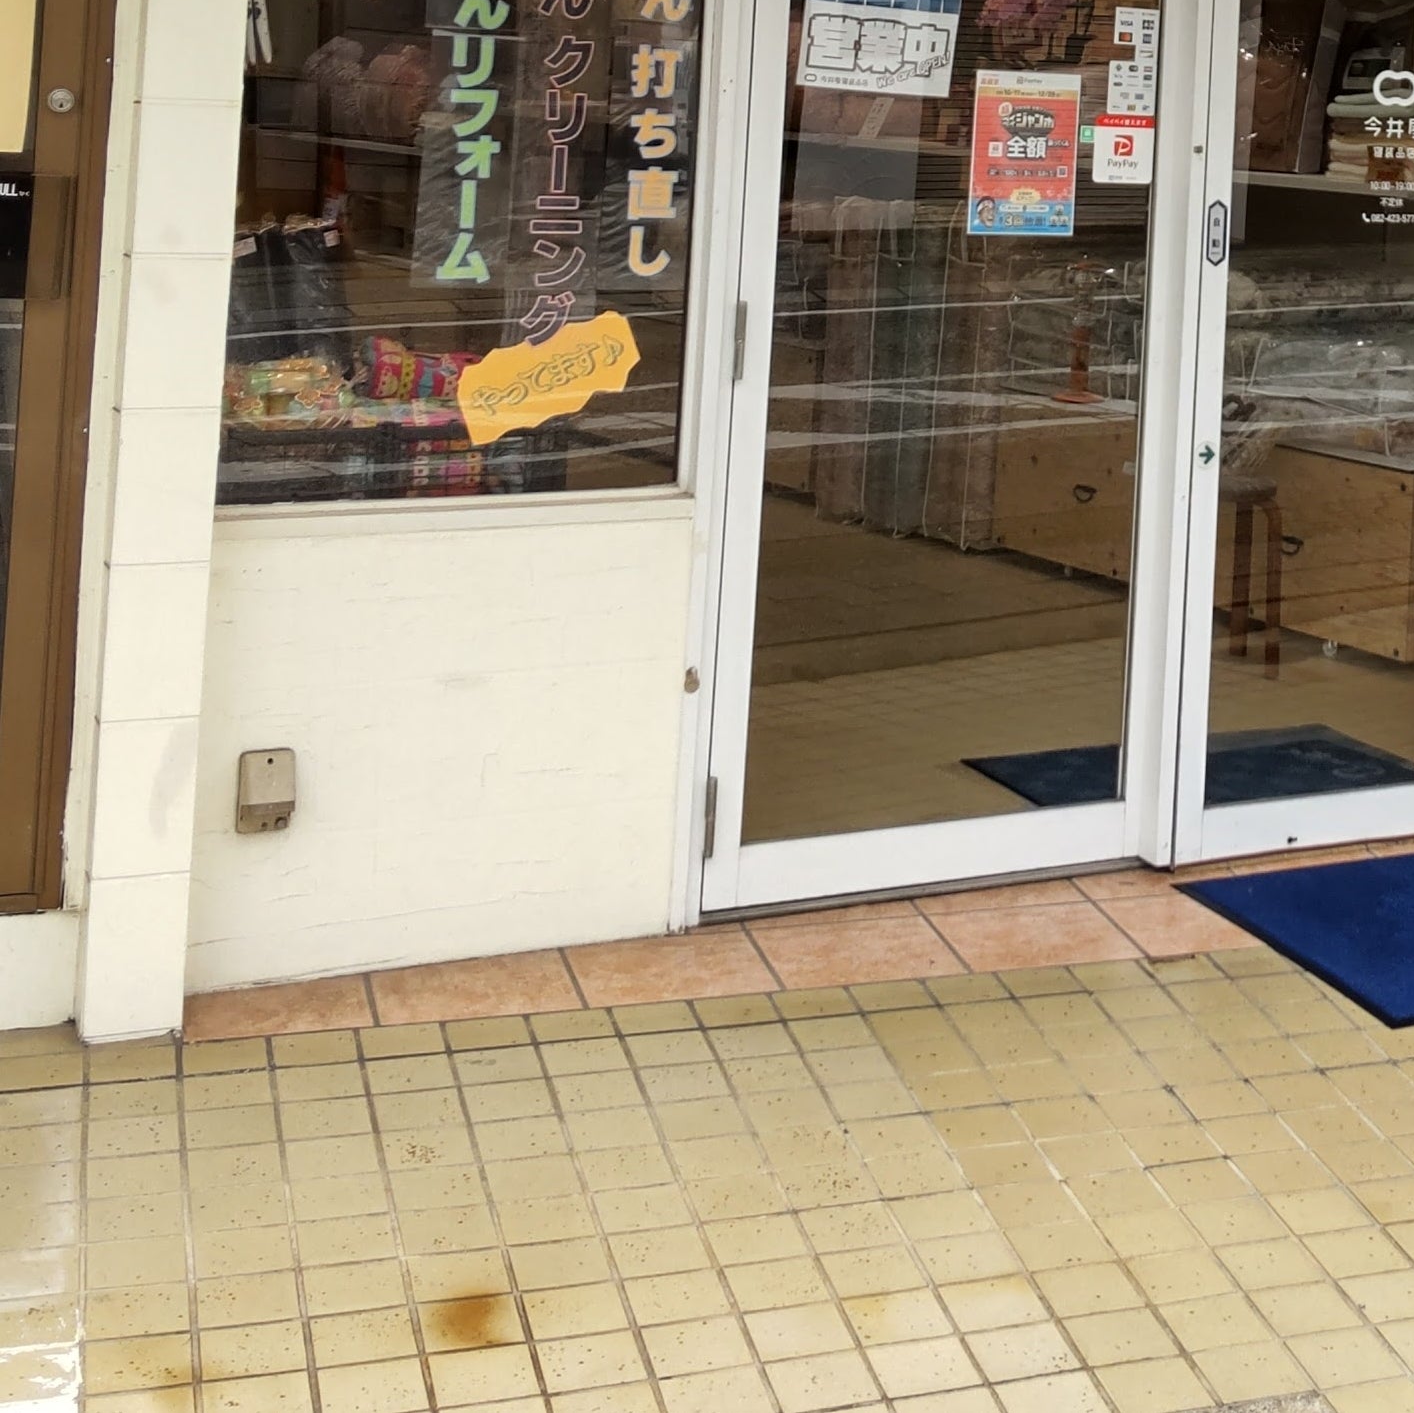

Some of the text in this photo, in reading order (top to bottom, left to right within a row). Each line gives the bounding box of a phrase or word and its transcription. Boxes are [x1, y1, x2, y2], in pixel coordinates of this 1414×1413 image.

[806, 13, 951, 78] 営業中
[1006, 135, 1047, 159] 全額
[1107, 158, 1138, 170] PayPay
